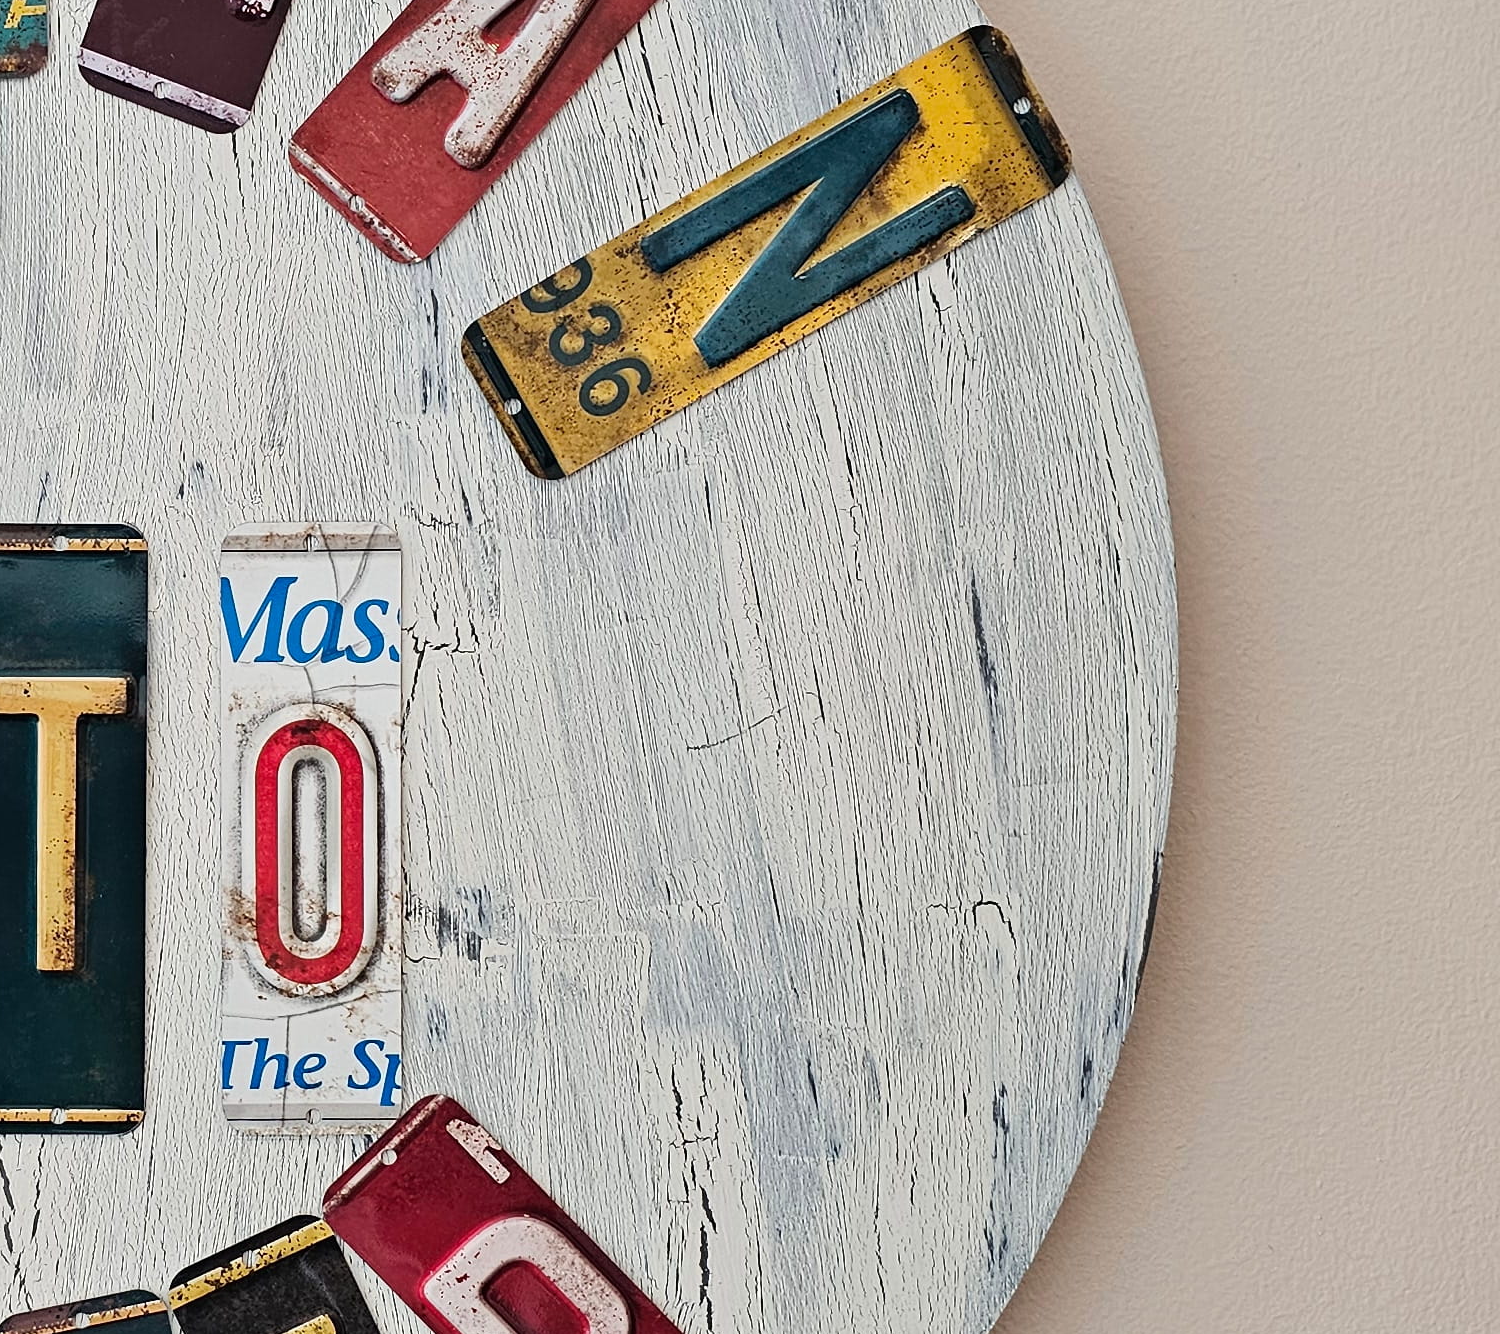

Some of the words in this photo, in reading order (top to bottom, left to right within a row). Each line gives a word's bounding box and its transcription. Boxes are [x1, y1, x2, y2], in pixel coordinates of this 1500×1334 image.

[521, 257, 652, 416] 936
[220, 576, 401, 663] Mas
[222, 1038, 326, 1090] The
